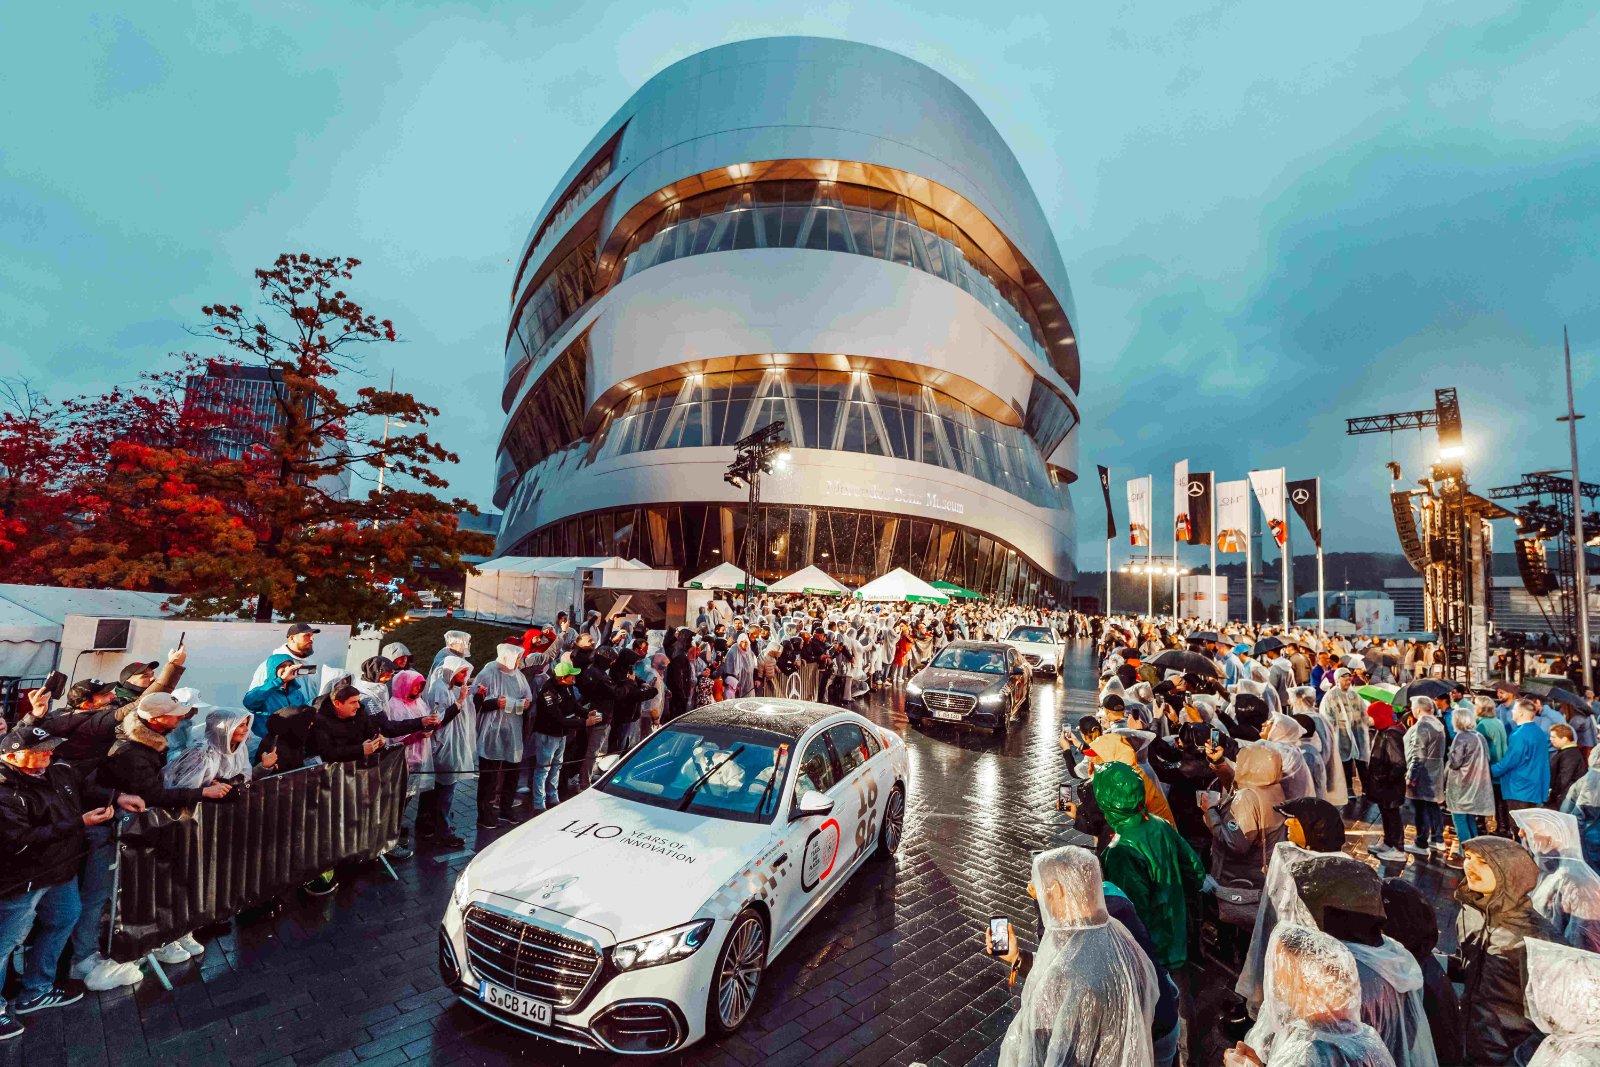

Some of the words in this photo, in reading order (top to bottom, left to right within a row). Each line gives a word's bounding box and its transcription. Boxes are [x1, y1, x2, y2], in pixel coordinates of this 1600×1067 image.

[926, 492, 964, 514] Museum
[559, 819, 623, 839] 140
[630, 830, 668, 845] YEARS
[669, 841, 688, 850] OF
[620, 837, 696, 864] INNOVATION
[490, 987, 497, 1003] S
[504, 993, 519, 1012] CB
[521, 1000, 546, 1021] 140
